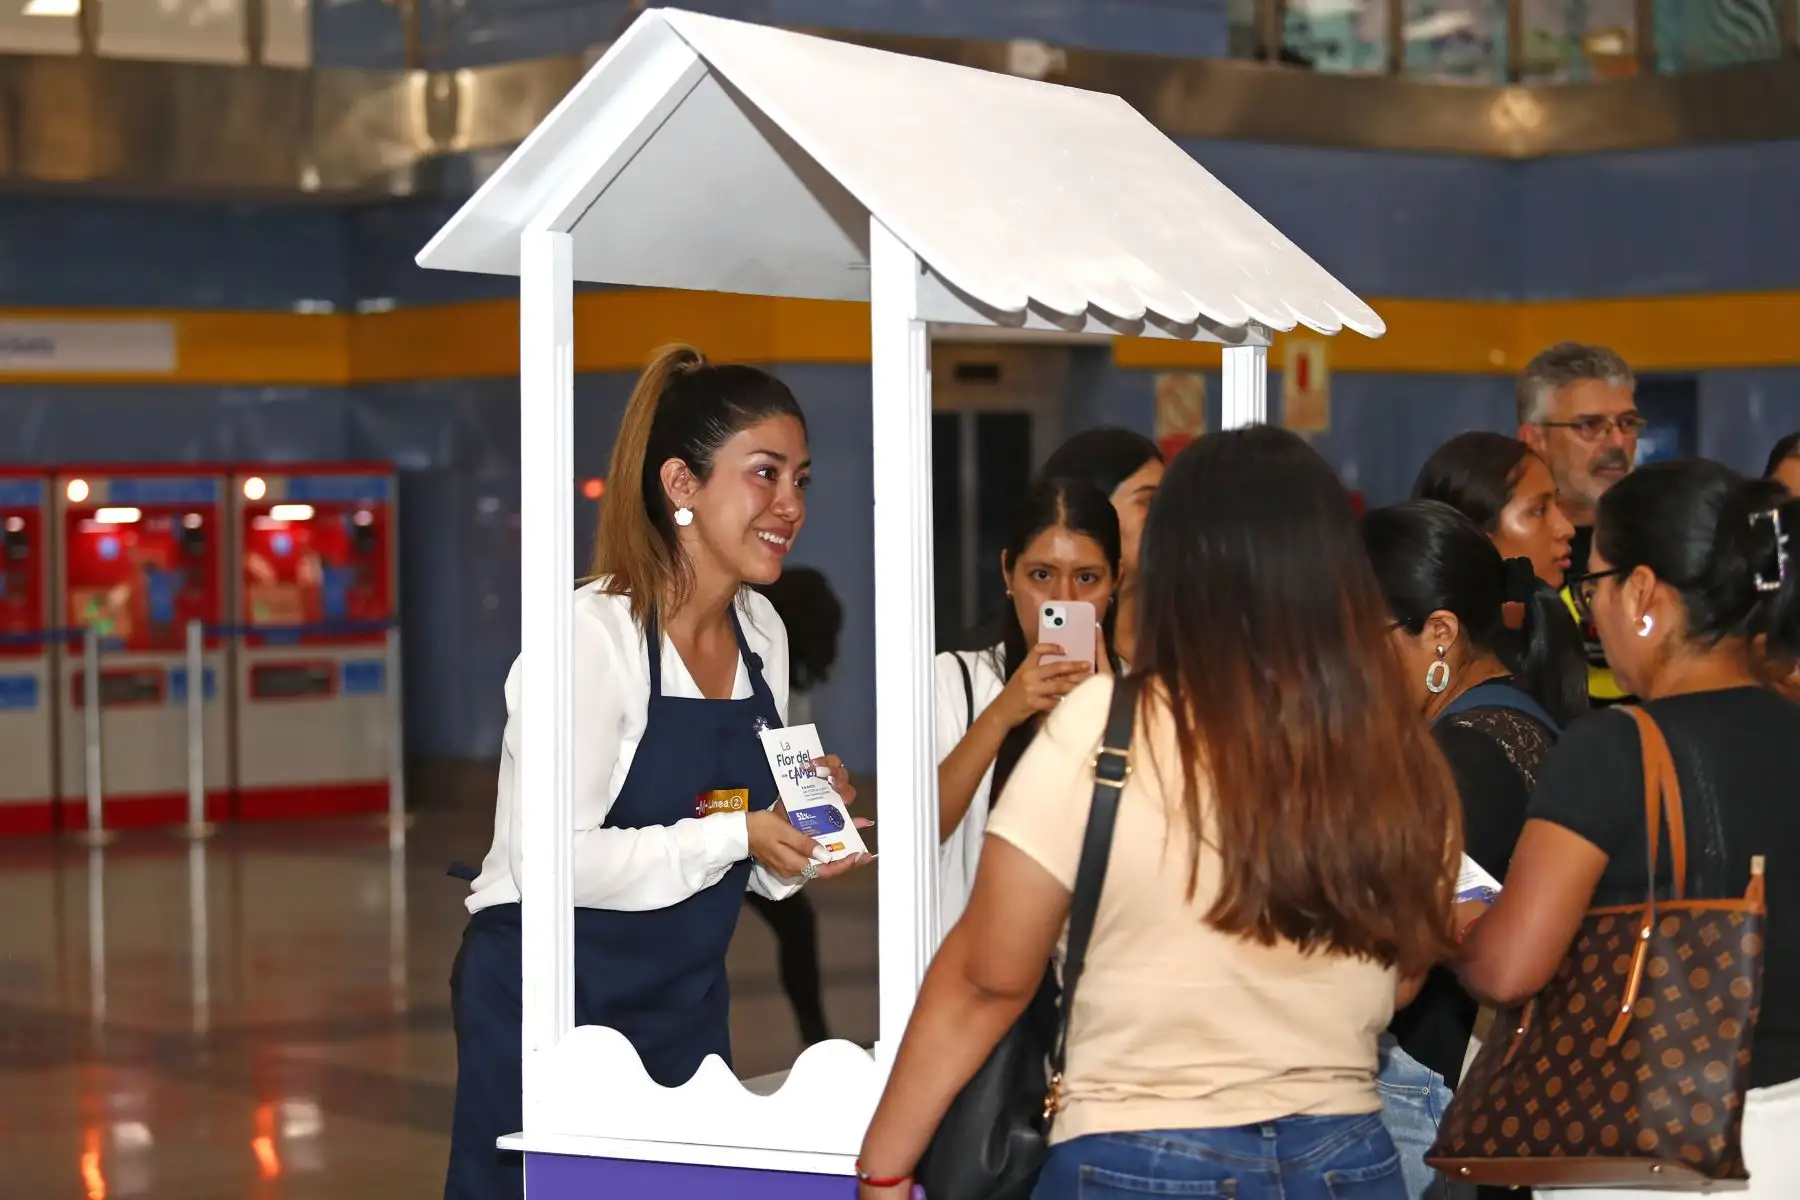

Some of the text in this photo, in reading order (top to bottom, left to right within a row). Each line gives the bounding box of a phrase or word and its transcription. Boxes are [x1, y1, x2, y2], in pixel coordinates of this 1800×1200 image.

[779, 740, 791, 751] La
[776, 749, 811, 767] Flor del
